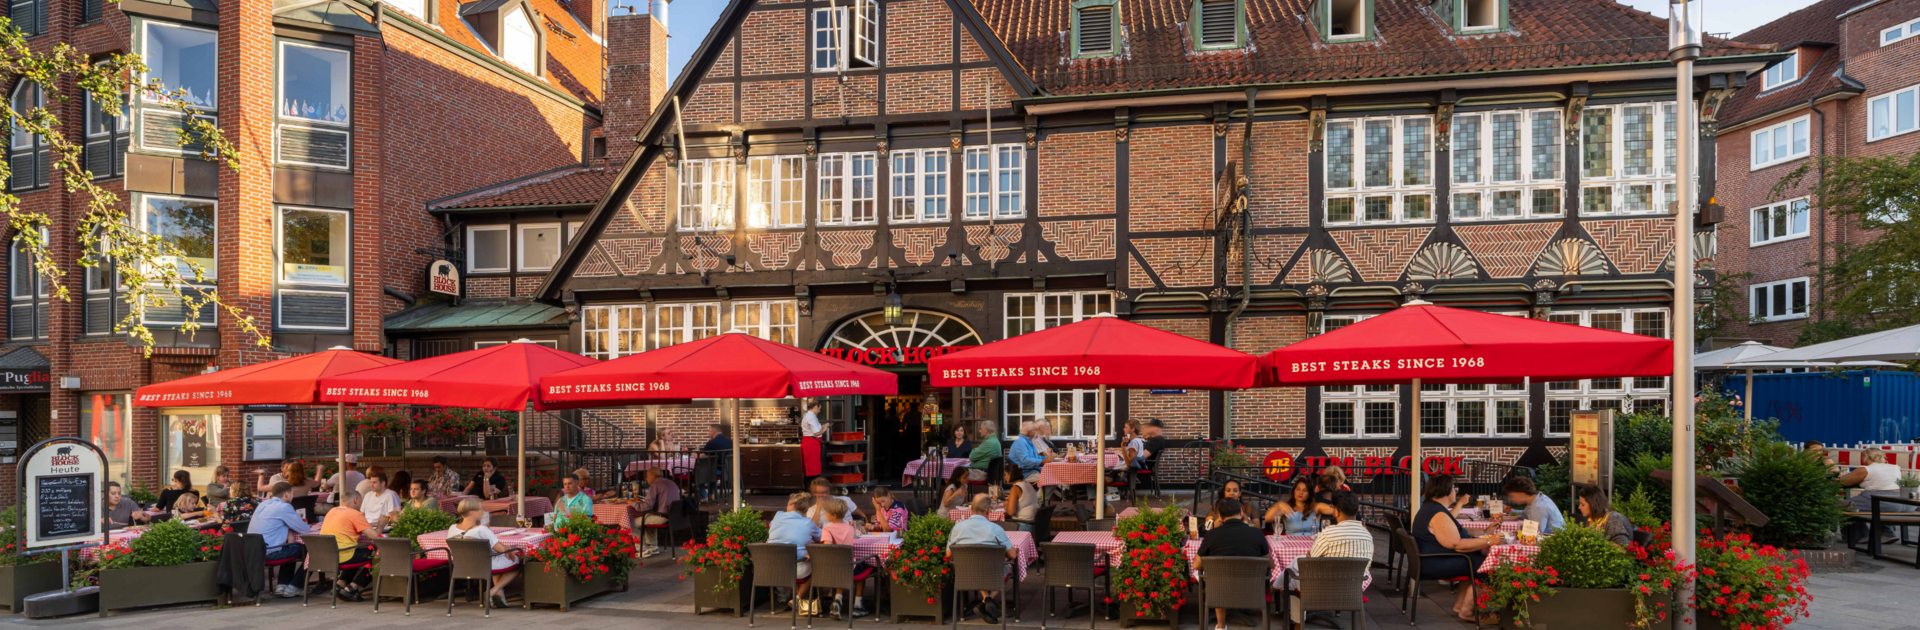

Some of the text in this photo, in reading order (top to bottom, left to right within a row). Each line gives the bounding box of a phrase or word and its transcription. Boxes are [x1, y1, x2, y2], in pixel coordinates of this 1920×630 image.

[434, 276, 456, 287] BLOCK
[434, 283, 456, 293] HOUSE
[1292, 358, 1484, 372] BEST STEAKS SINCE 1968
[6, 371, 49, 384] Puglia
[943, 366, 1100, 378] BEST STEAKS SINCE 1968
[549, 382, 669, 394] BEST STEAKS SINCE 1968
[799, 381, 813, 389] BEST
[192, 391, 214, 399] SINCE
[1266, 458, 1290, 474] JB
[1300, 456, 1354, 475] JIM
